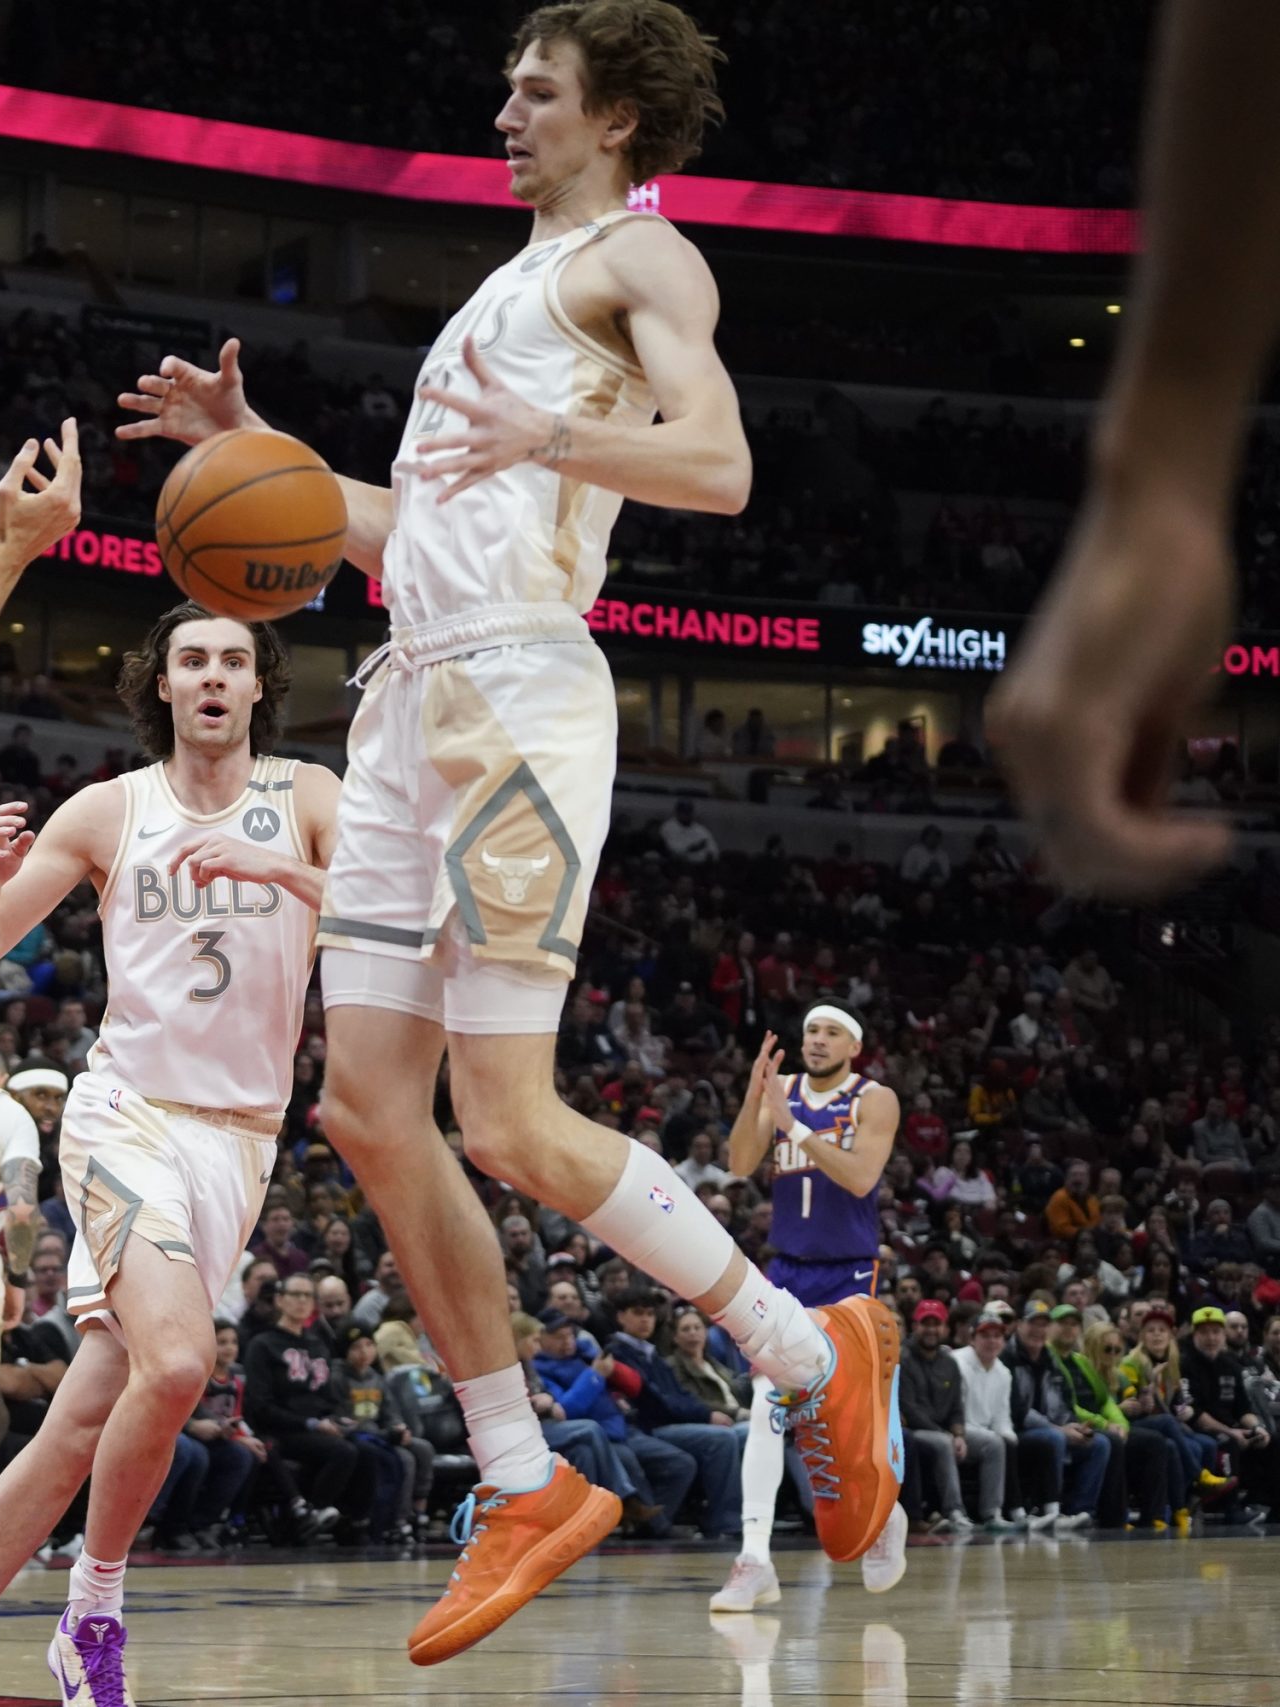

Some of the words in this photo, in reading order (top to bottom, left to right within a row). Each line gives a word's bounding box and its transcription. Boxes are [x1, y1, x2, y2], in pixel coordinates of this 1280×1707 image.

[586, 598, 820, 651] ERCHANDISE
[862, 617, 1006, 667] SKYHIGH
[1210, 644, 1280, 677] OM
[188, 931, 232, 1004] 3
[801, 1176, 813, 1219] 1
